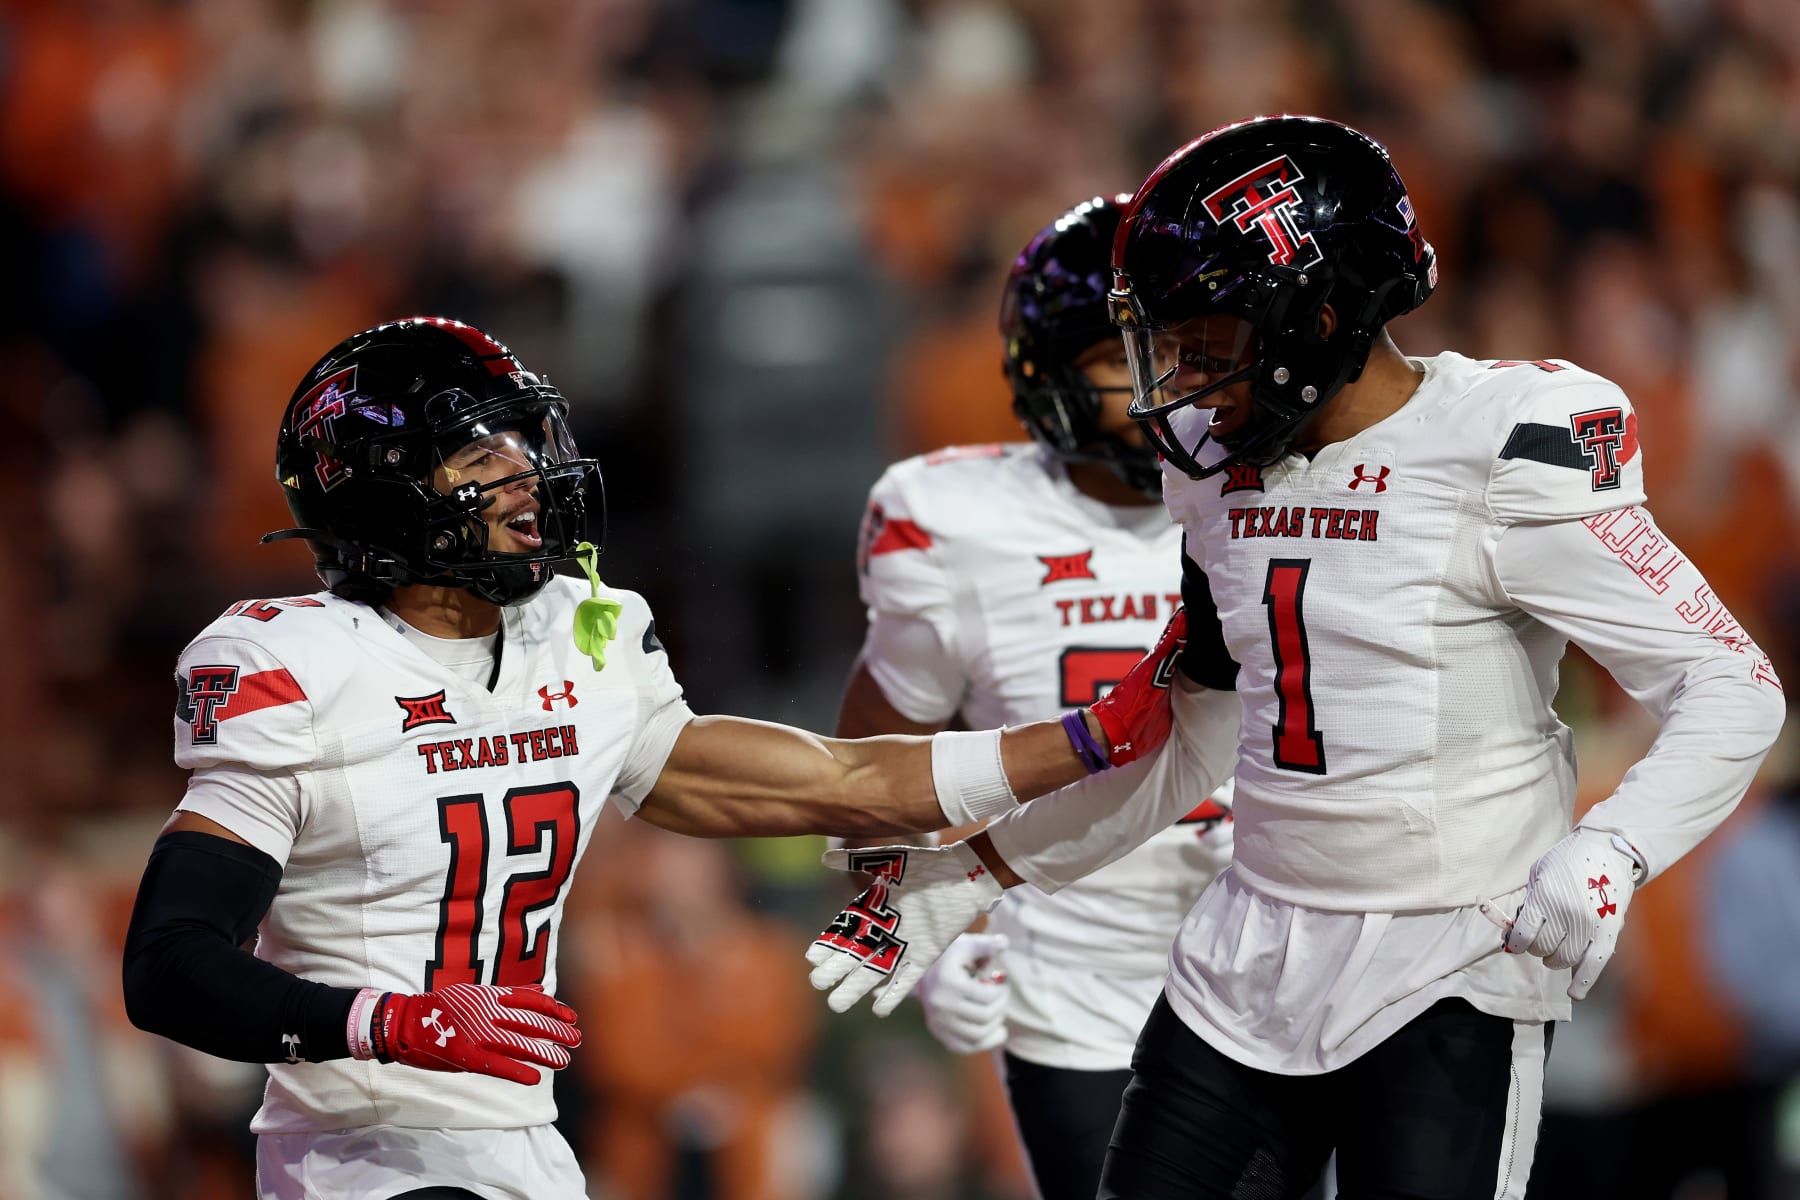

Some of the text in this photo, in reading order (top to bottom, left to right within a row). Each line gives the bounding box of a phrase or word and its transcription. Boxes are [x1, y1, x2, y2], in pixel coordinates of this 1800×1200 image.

[1228, 507, 1379, 541] TEXAS TECH
[1056, 596, 1157, 626] TEXAS
[1261, 558, 1327, 775] 1
[395, 689, 457, 733] XII
[417, 725, 579, 774] TEXAS TECH
[424, 781, 580, 993] 12
